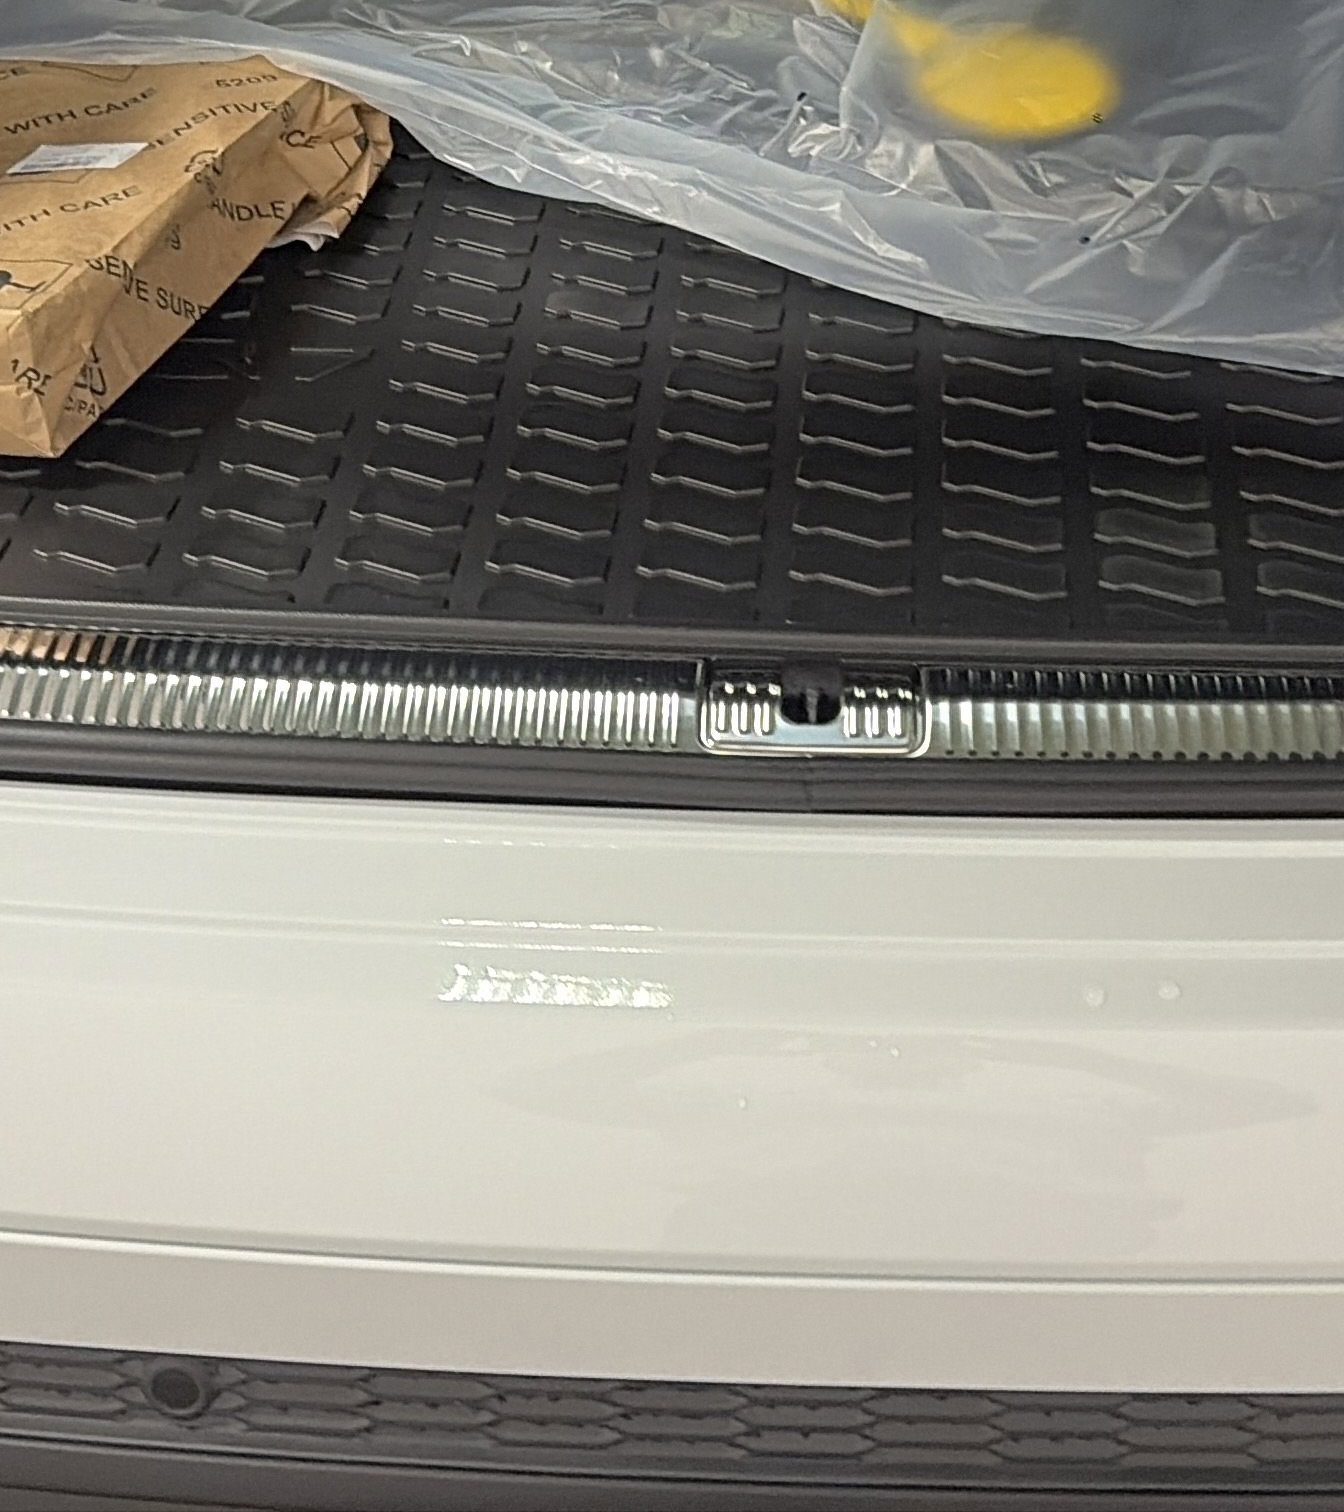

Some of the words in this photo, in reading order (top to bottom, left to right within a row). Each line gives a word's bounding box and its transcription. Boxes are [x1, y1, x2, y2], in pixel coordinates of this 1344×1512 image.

[3, 109, 77, 136] WITH
[83, 87, 156, 117] CARE
[59, 185, 144, 213] CARE
